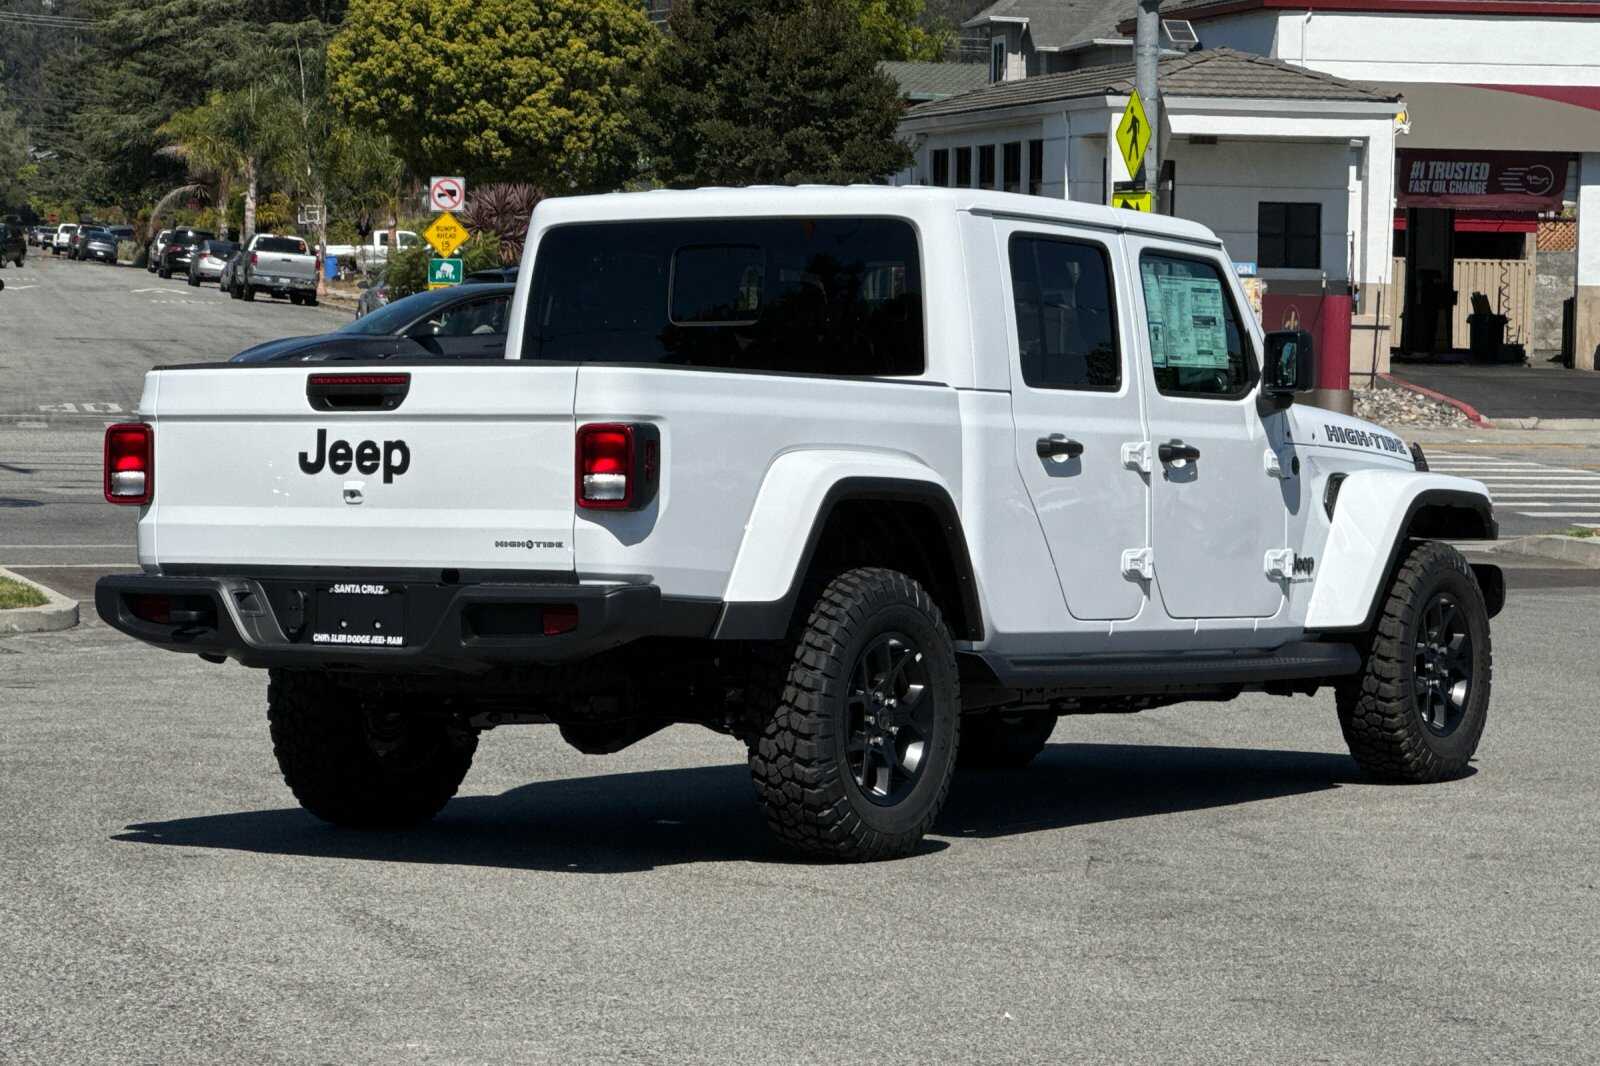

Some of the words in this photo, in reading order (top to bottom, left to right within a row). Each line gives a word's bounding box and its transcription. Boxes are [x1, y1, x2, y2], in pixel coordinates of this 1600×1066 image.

[1428, 161, 1490, 181] TRUSTED
[1408, 180, 1433, 193] FAST
[1432, 180, 1448, 194] OIL
[1449, 181, 1489, 195] CHANGE
[298, 428, 411, 484] Jeep
[334, 584, 361, 593] SANTA
[361, 584, 384, 595] CRUZ
[347, 634, 371, 644] DODGE
[386, 636, 403, 646] RAM
